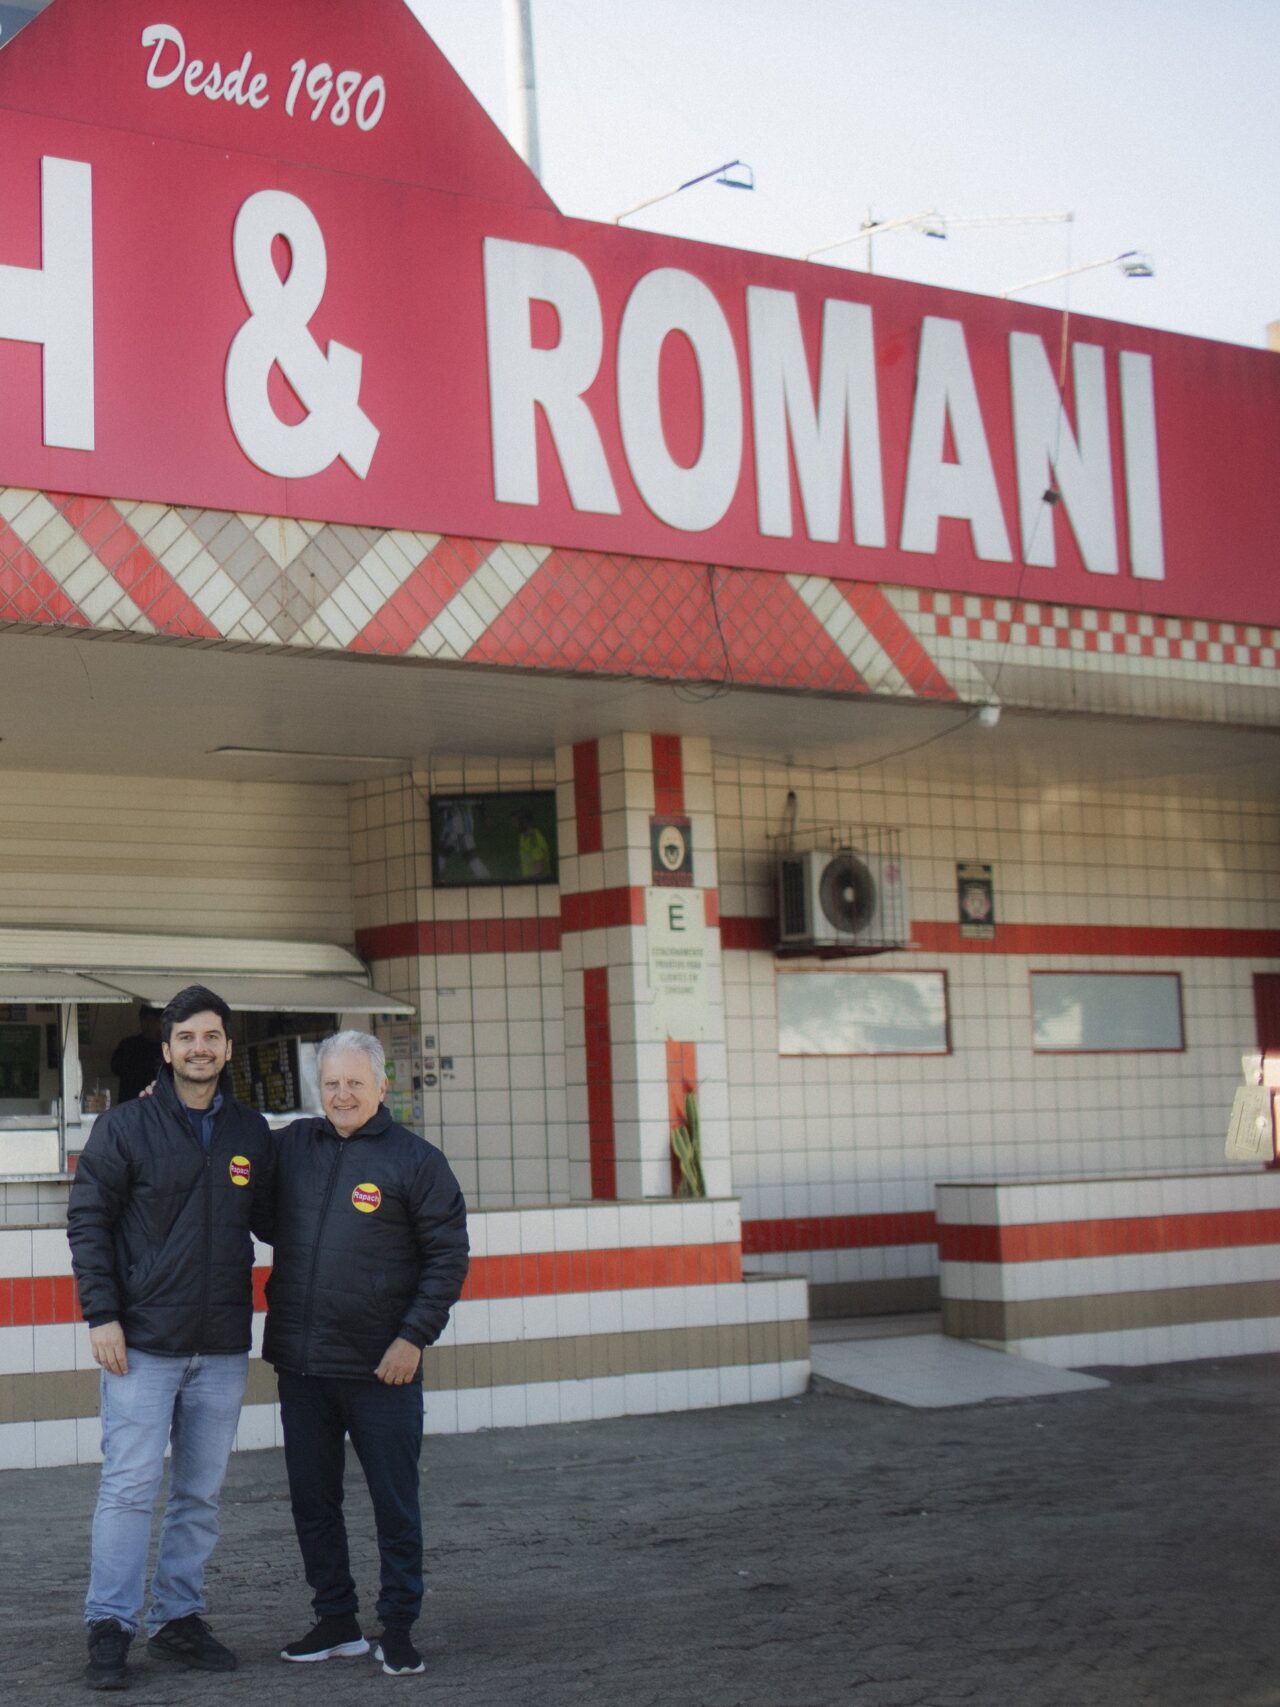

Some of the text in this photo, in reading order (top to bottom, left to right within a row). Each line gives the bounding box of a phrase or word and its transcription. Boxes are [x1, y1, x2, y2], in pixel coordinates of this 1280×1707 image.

[142, 23, 386, 132] Desde 1980
[225, 190, 381, 481] &
[483, 236, 1165, 581] ROMANI
[668, 905, 685, 931] E
[353, 1190, 380, 1203] Rapach
